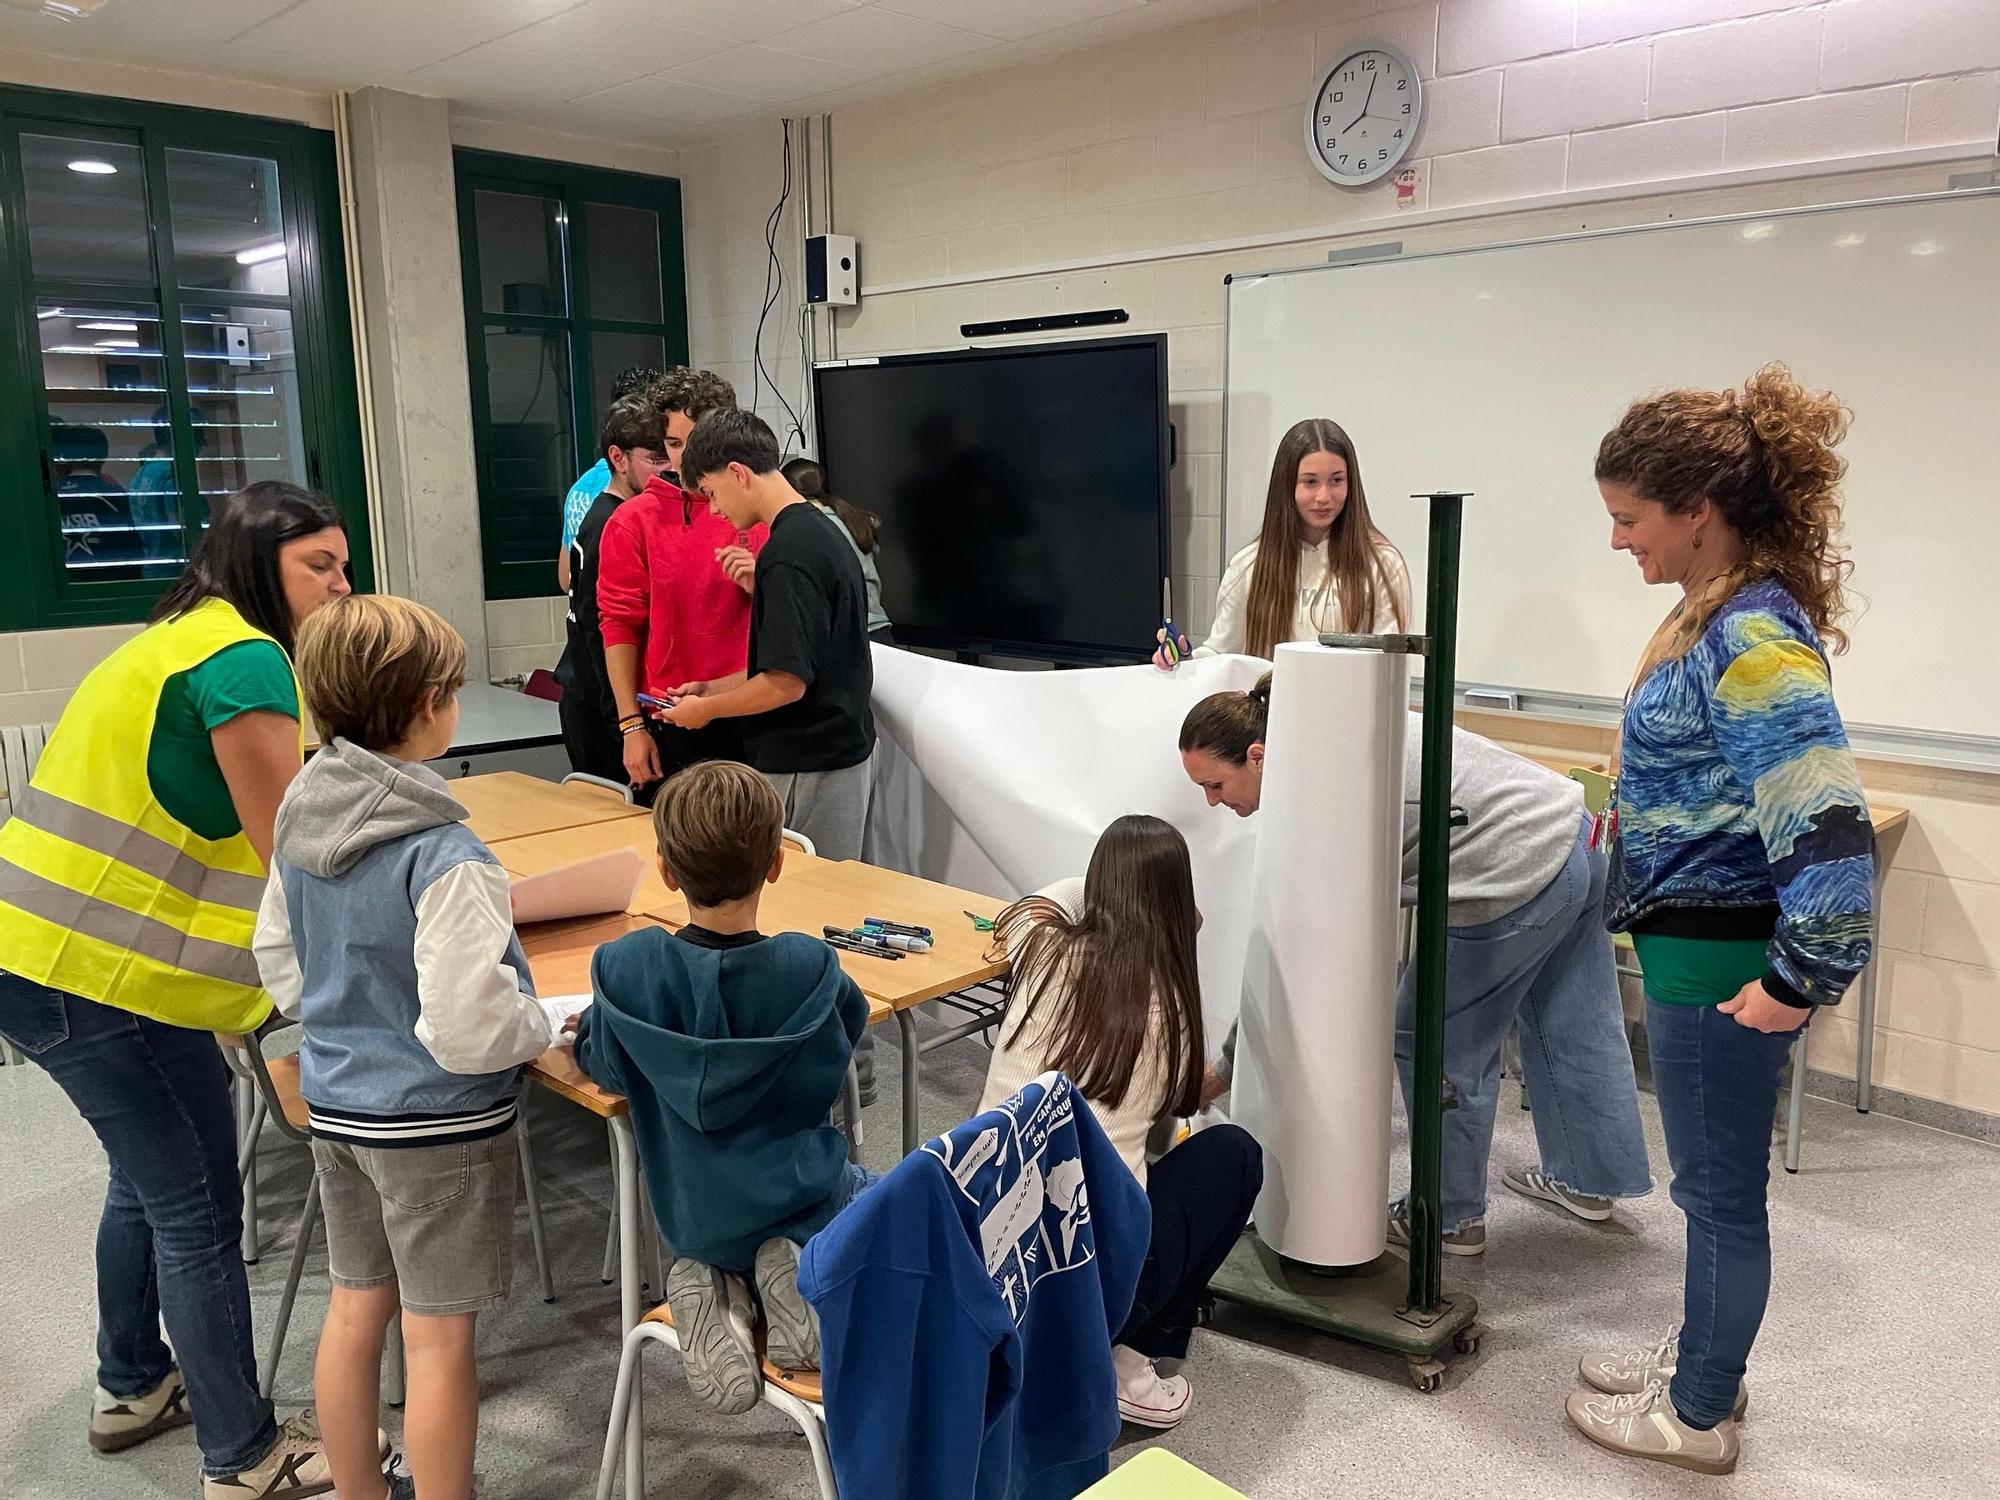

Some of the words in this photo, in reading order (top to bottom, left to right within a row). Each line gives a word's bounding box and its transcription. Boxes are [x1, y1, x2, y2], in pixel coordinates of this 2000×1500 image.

[1361, 60, 1376, 72] 12
[1343, 72, 1355, 82] 11
[1397, 80, 1406, 91] 2
[1329, 92, 1343, 103] 10
[1401, 104, 1411, 114] 3
[1322, 115, 1331, 126] 9
[1393, 129, 1403, 140] 4
[1327, 139, 1336, 148] 8
[1339, 154, 1348, 165] 7
[1378, 149, 1388, 160] 5
[1358, 159, 1367, 169] 6
[1052, 1081, 1065, 1101] QUE
[1033, 1130, 1046, 1148] EM
